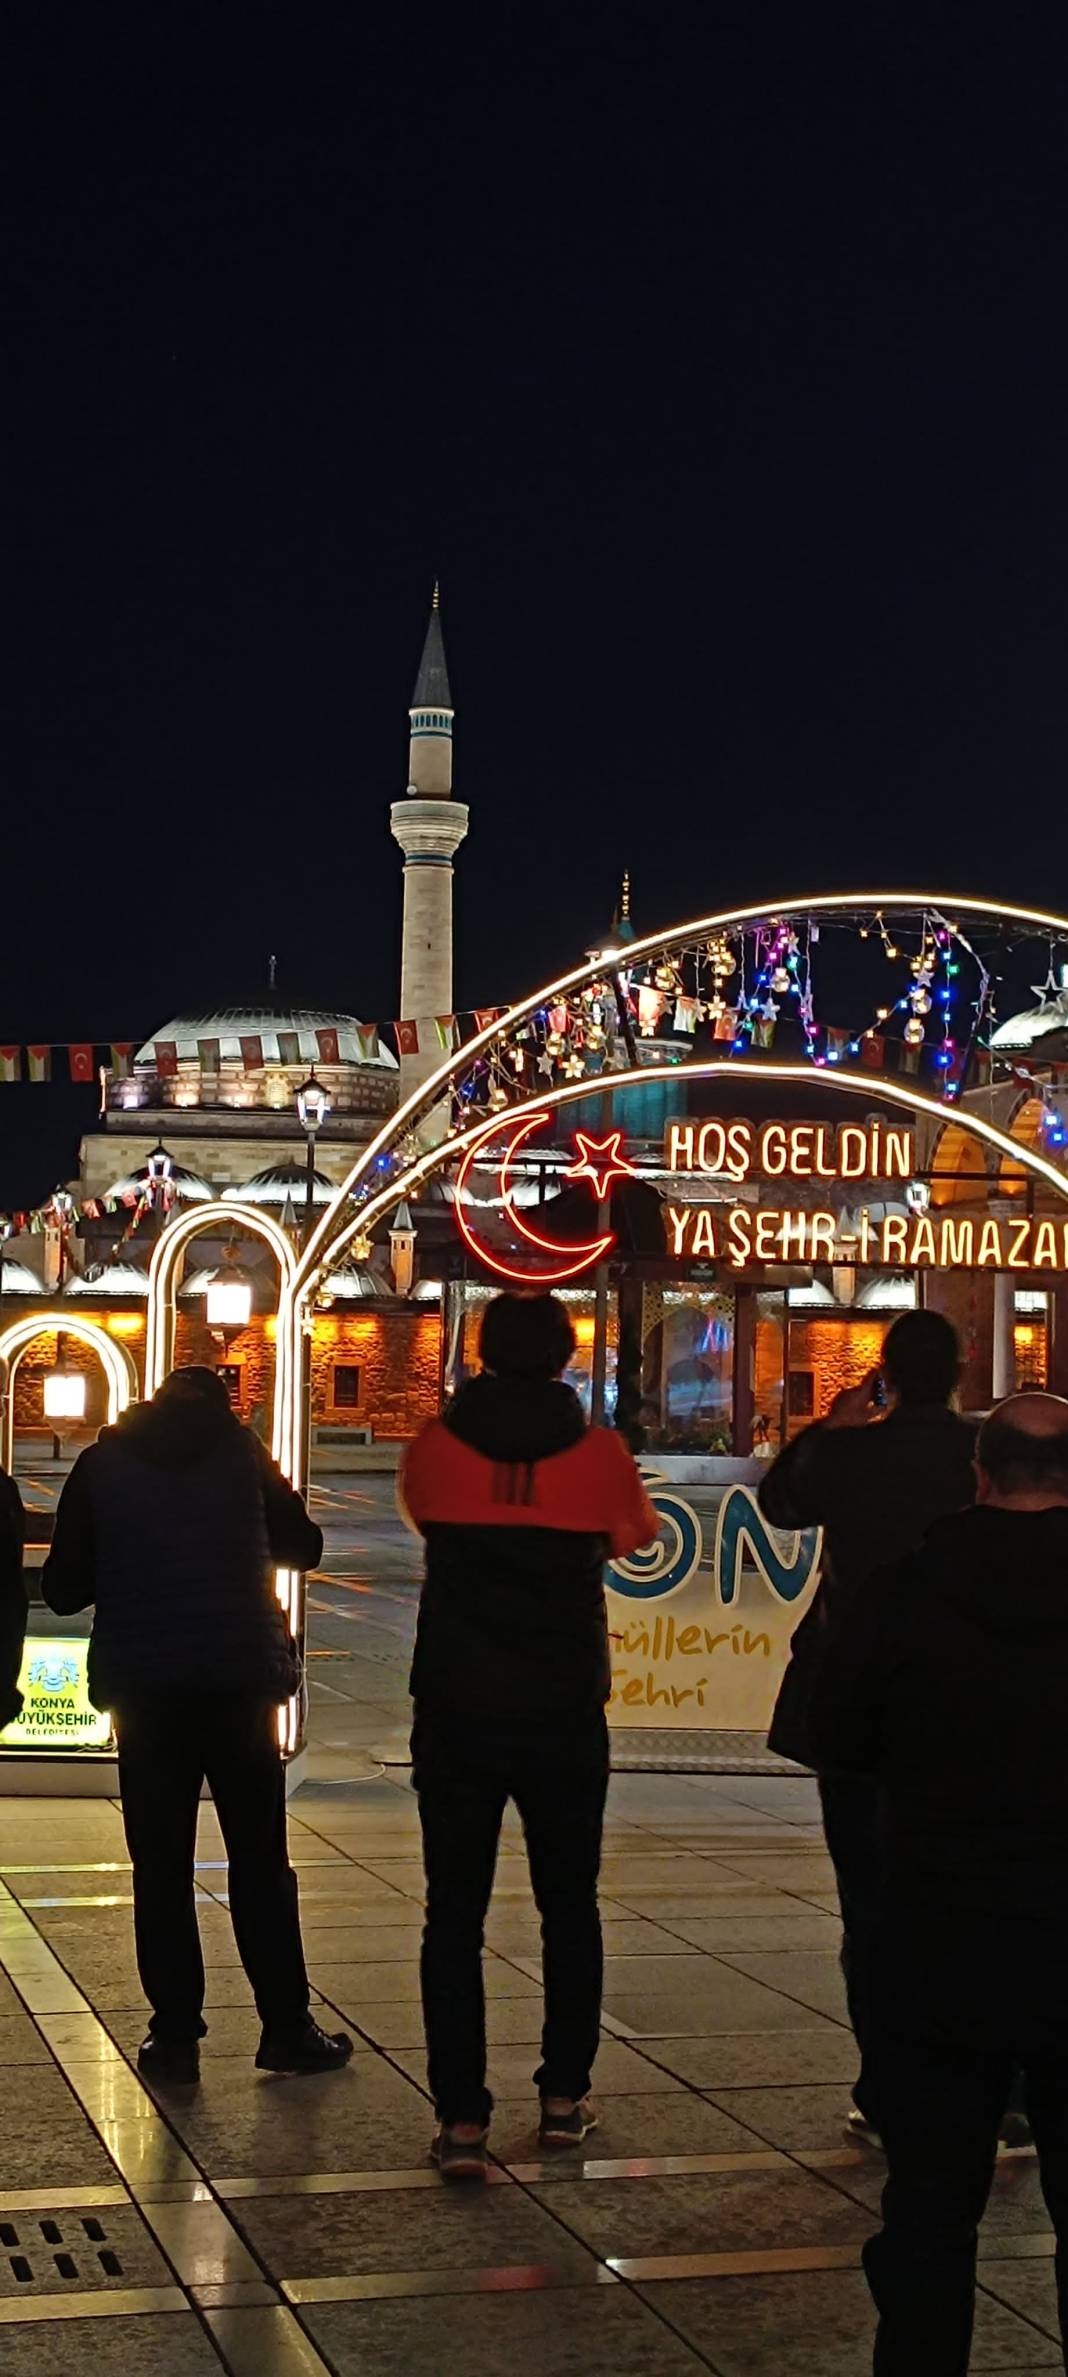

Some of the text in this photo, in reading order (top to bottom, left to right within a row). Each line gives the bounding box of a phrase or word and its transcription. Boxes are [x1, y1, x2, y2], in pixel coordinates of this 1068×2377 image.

[669, 1120, 911, 1182] HOŞ GELDİN
[669, 1207, 716, 1256] YA
[727, 1208, 870, 1268] ŞEHR-İ
[30, 1697, 75, 1709] KONYA
